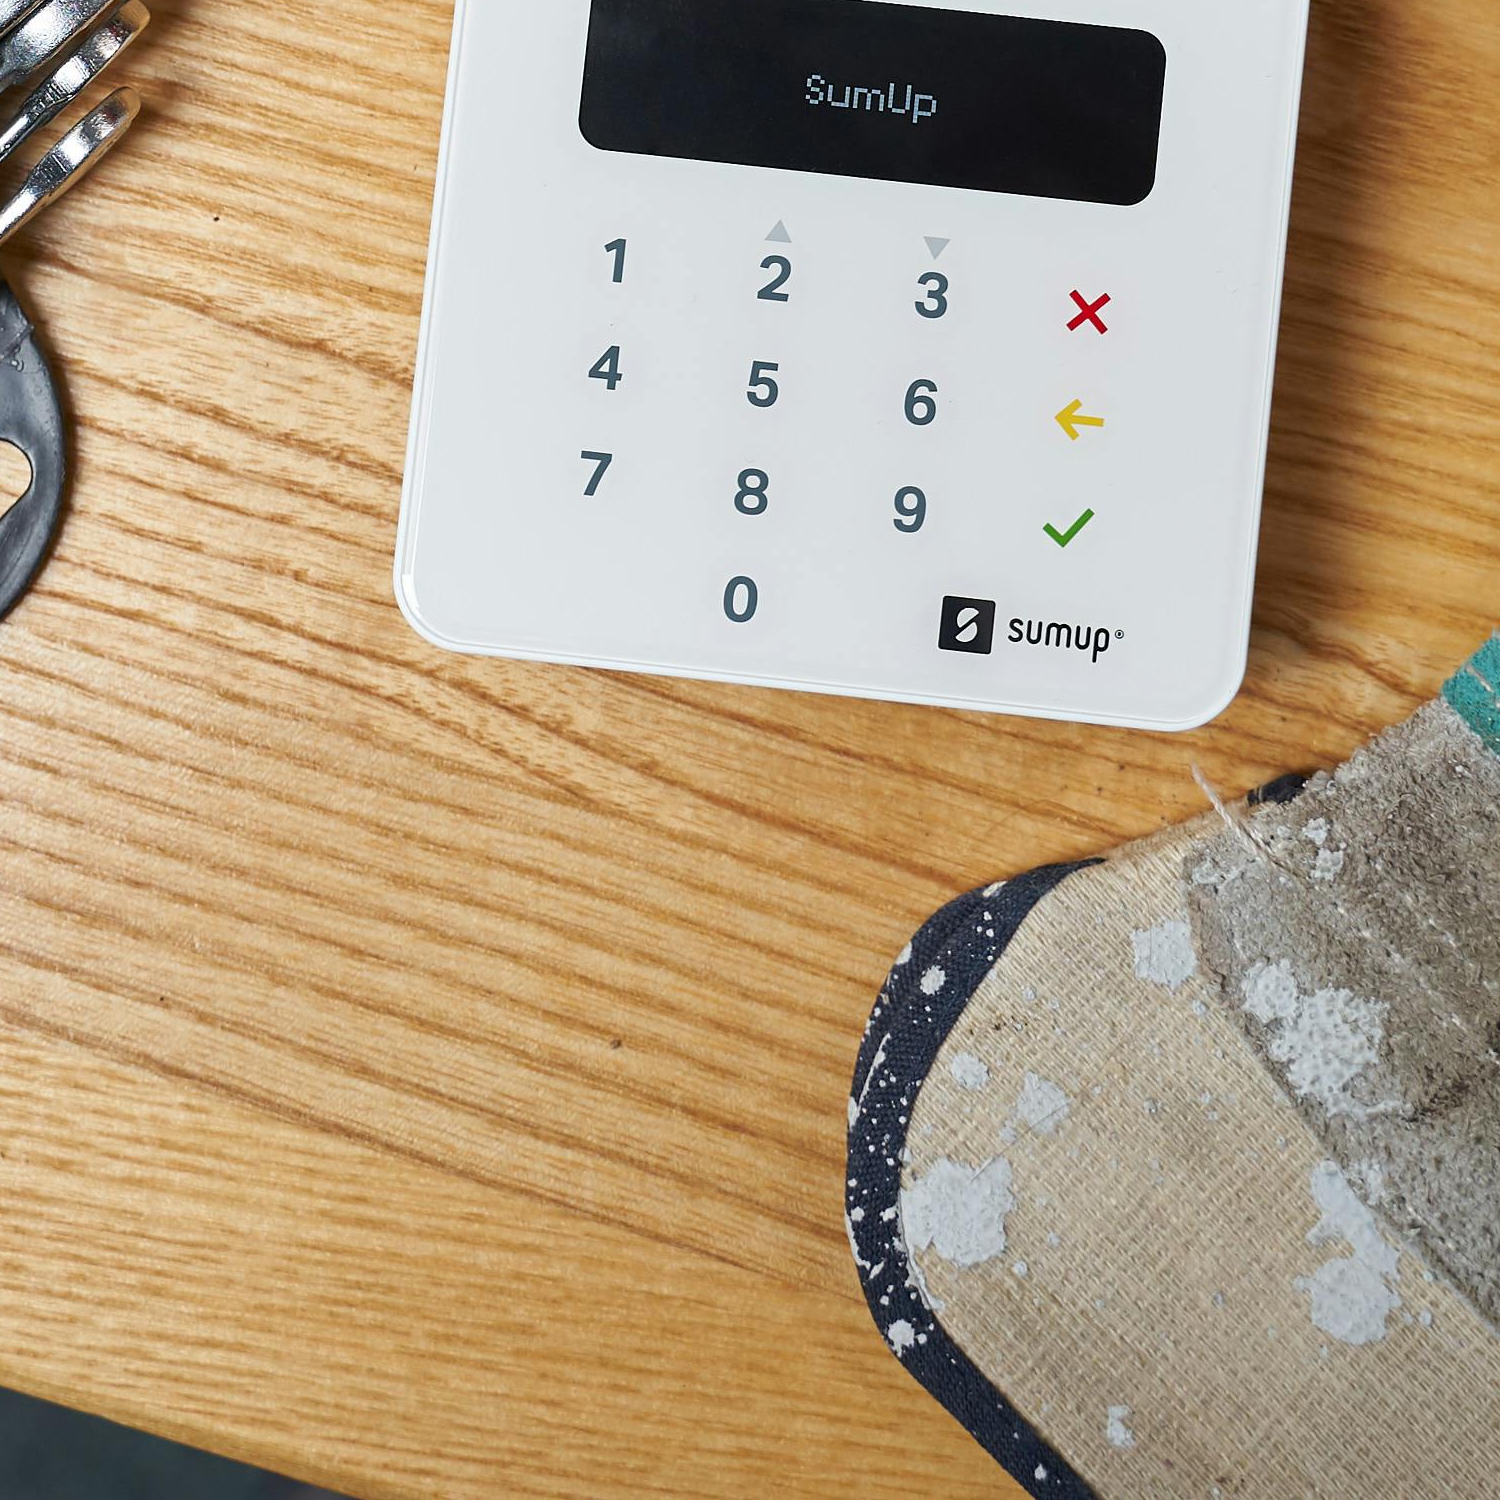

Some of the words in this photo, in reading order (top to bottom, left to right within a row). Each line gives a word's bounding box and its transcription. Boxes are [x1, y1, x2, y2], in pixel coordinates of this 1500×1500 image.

[805, 74, 937, 124] SumUp
[604, 238, 627, 284] 1
[756, 254, 792, 303] 2
[914, 271, 949, 319] 3
[587, 345, 623, 391] 4
[746, 360, 779, 408] 5
[904, 378, 938, 426] 6
[580, 450, 613, 497] 7
[733, 468, 769, 516] 8
[893, 485, 927, 534] 9
[723, 575, 758, 623] 0
